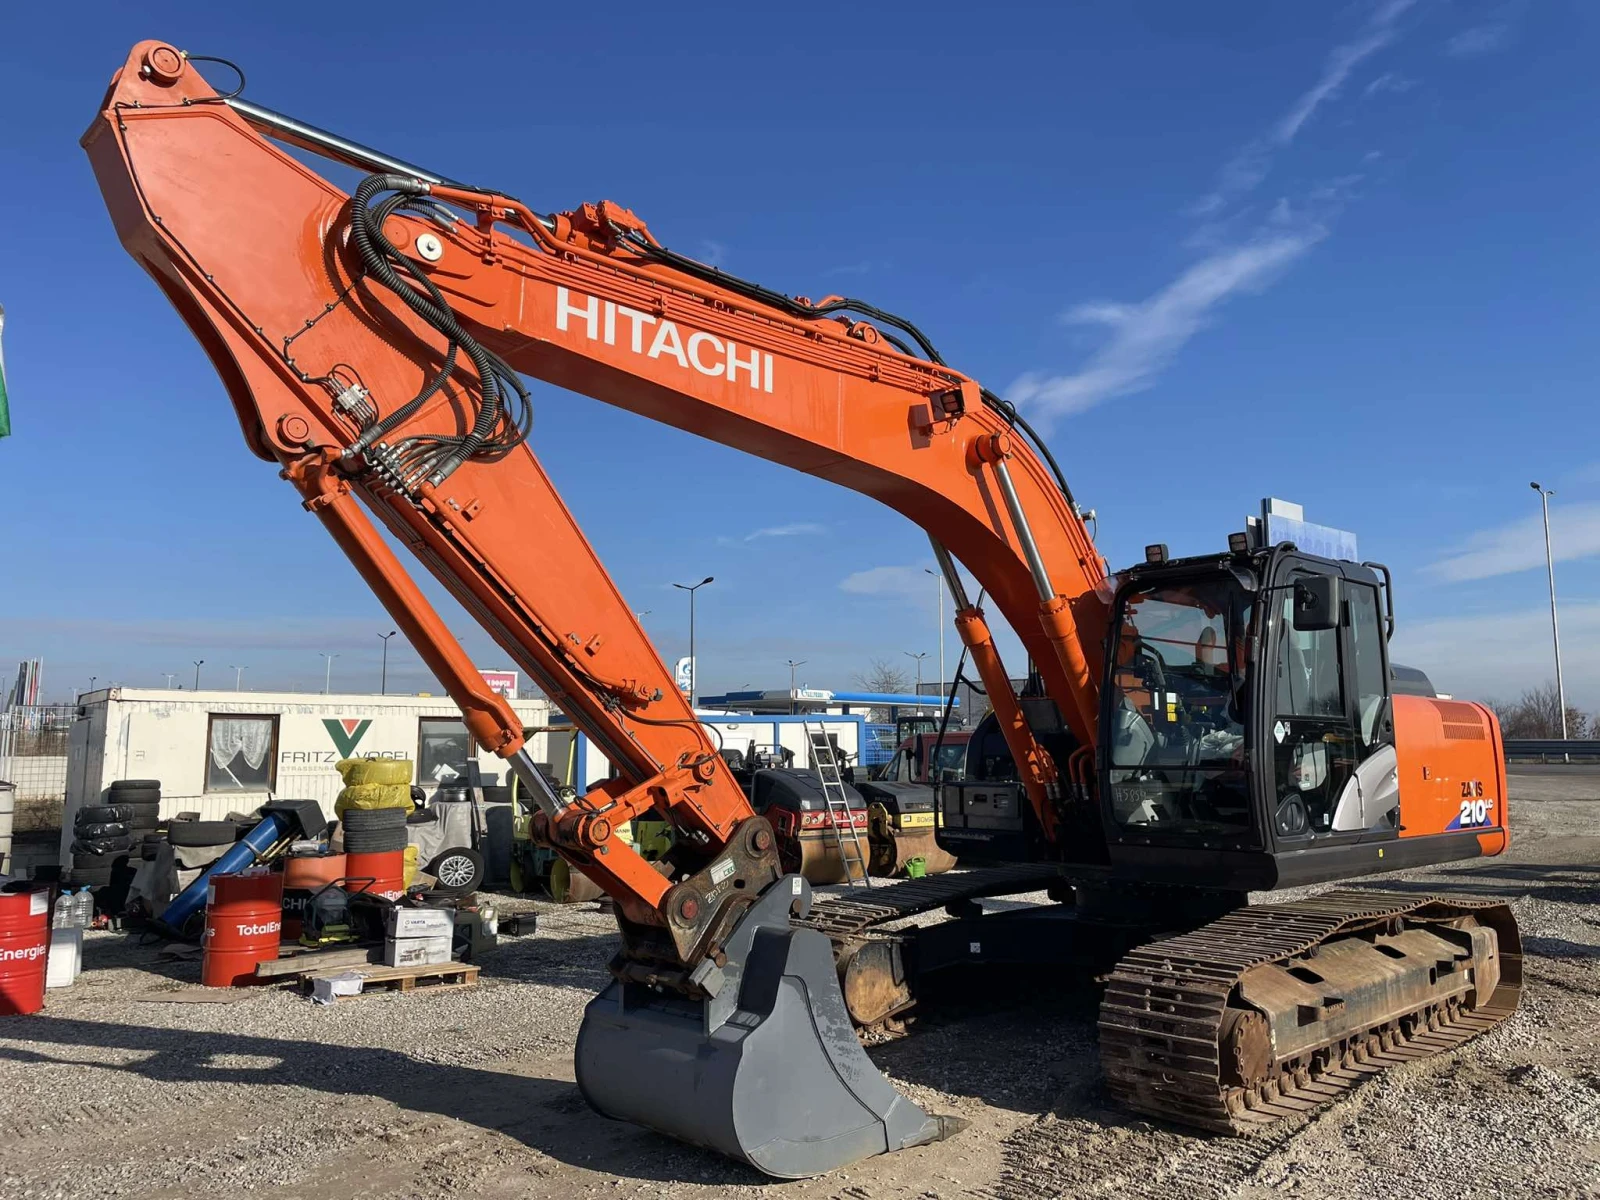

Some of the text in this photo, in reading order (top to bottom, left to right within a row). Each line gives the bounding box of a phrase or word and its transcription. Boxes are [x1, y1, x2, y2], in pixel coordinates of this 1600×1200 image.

[556, 285, 773, 394] HITACHI
[281, 751, 336, 763] FRITZ
[280, 765, 335, 773] STRASSENBA
